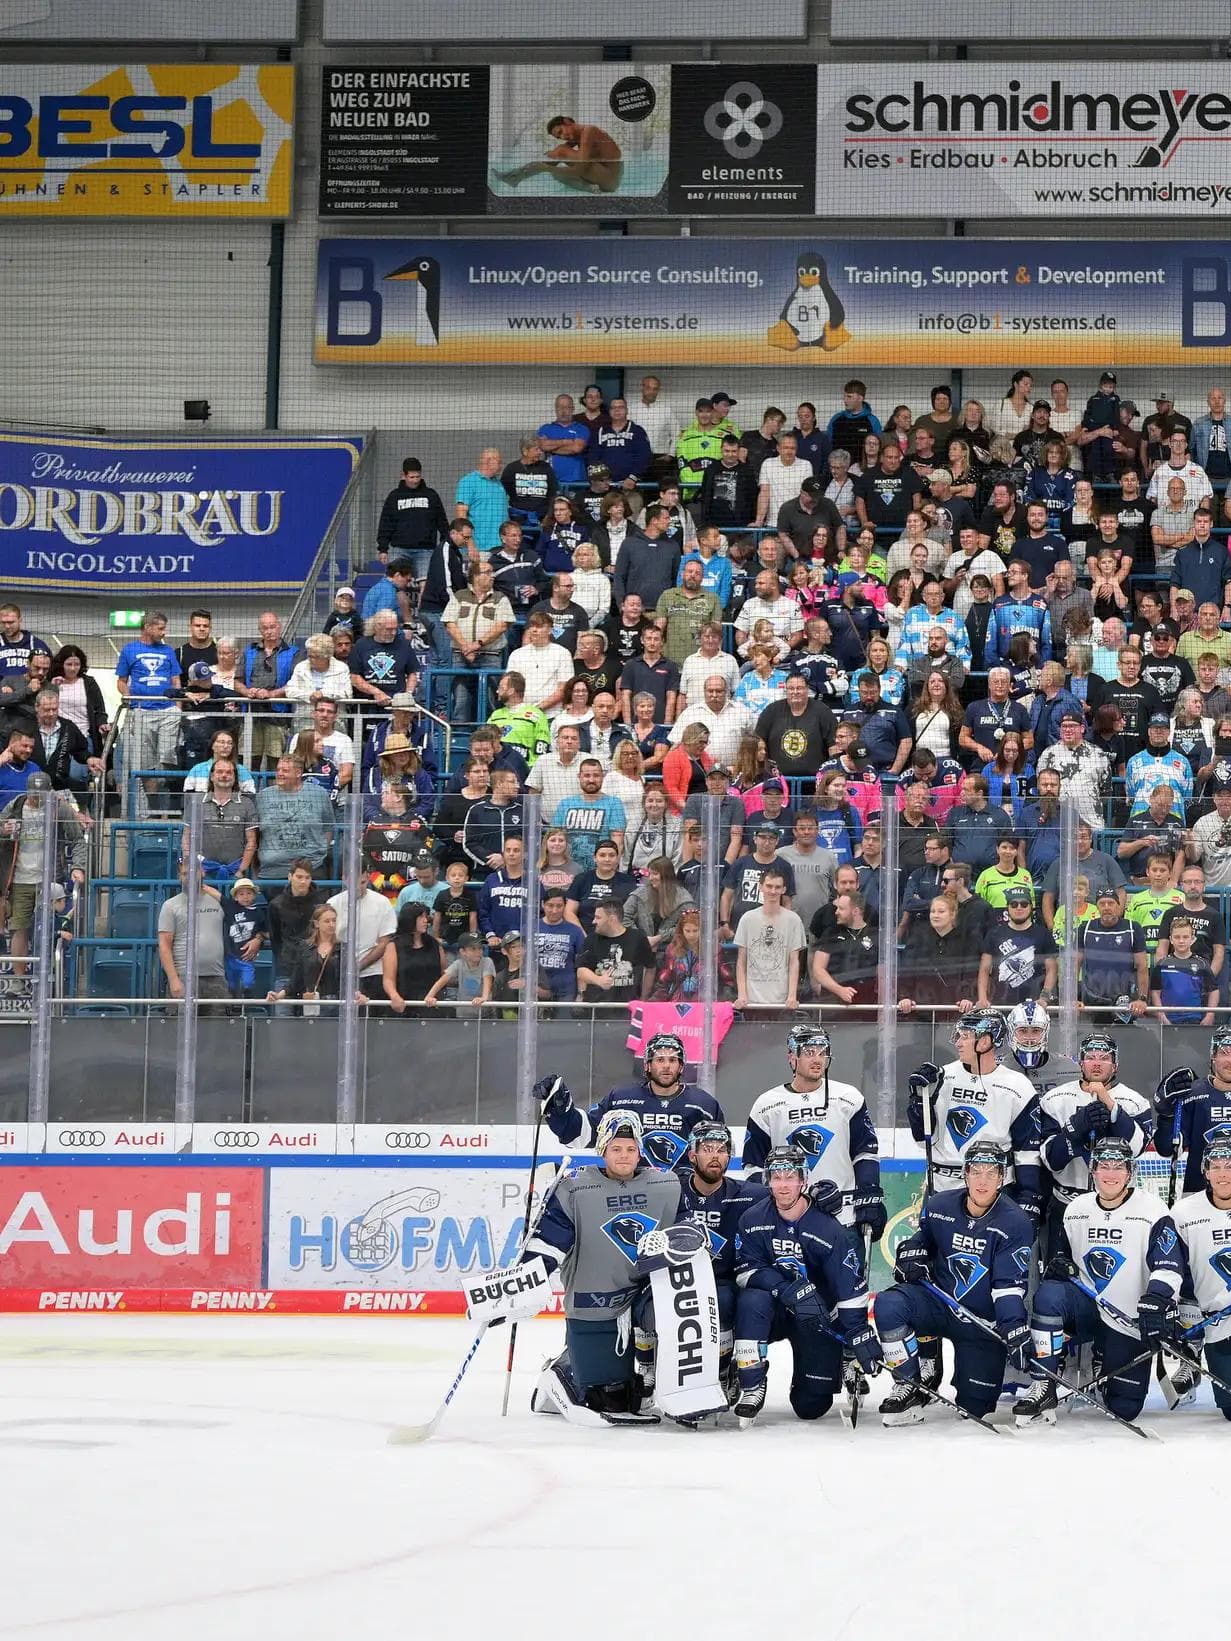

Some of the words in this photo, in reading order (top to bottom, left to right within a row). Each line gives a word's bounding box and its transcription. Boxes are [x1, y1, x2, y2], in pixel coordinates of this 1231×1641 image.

[331, 73, 366, 89] DER
[370, 73, 470, 89] EINFACHSTE
[330, 93, 369, 108] WEG
[373, 93, 411, 108] ZUM
[330, 112, 389, 128] NEUEN
[394, 112, 430, 128] BAD
[843, 149, 891, 169] Kies
[909, 149, 995, 169] Erdbau
[1013, 149, 1117, 169] Abbruch
[702, 165, 784, 180] elements
[110, 184, 120, 196] &
[144, 184, 261, 197] STAPLER
[687, 192, 705, 200] BAD
[714, 192, 751, 200] HEIZUNG
[761, 192, 798, 200] ENERGIE
[468, 266, 581, 288] Linux/Open
[586, 266, 651, 284] Source
[656, 265, 764, 288] Consulting,
[844, 266, 928, 289] Training,
[932, 266, 1009, 288] Support
[1015, 267, 1031, 285] &
[1037, 266, 1166, 287] Development
[507, 313, 699, 332] www.b1-systems.de
[918, 312, 1117, 332] info@b1-systems.de
[31, 452, 197, 484] Privatbrauerei
[26, 550, 195, 574] INGOLSTADT
[951, 1087, 988, 1102] ERC
[643, 1113, 683, 1125] ERC
[114, 1130, 166, 1147] Audi
[268, 1131, 318, 1148] Audi
[439, 1133, 489, 1148] Audi
[606, 1194, 648, 1207] ERC
[0, 1191, 232, 1257] Audi
[952, 1232, 987, 1249] ERC
[1087, 1227, 1123, 1240] ERC
[468, 1270, 547, 1305] BÜCHL
[667, 1262, 696, 1387] BÜCHL
